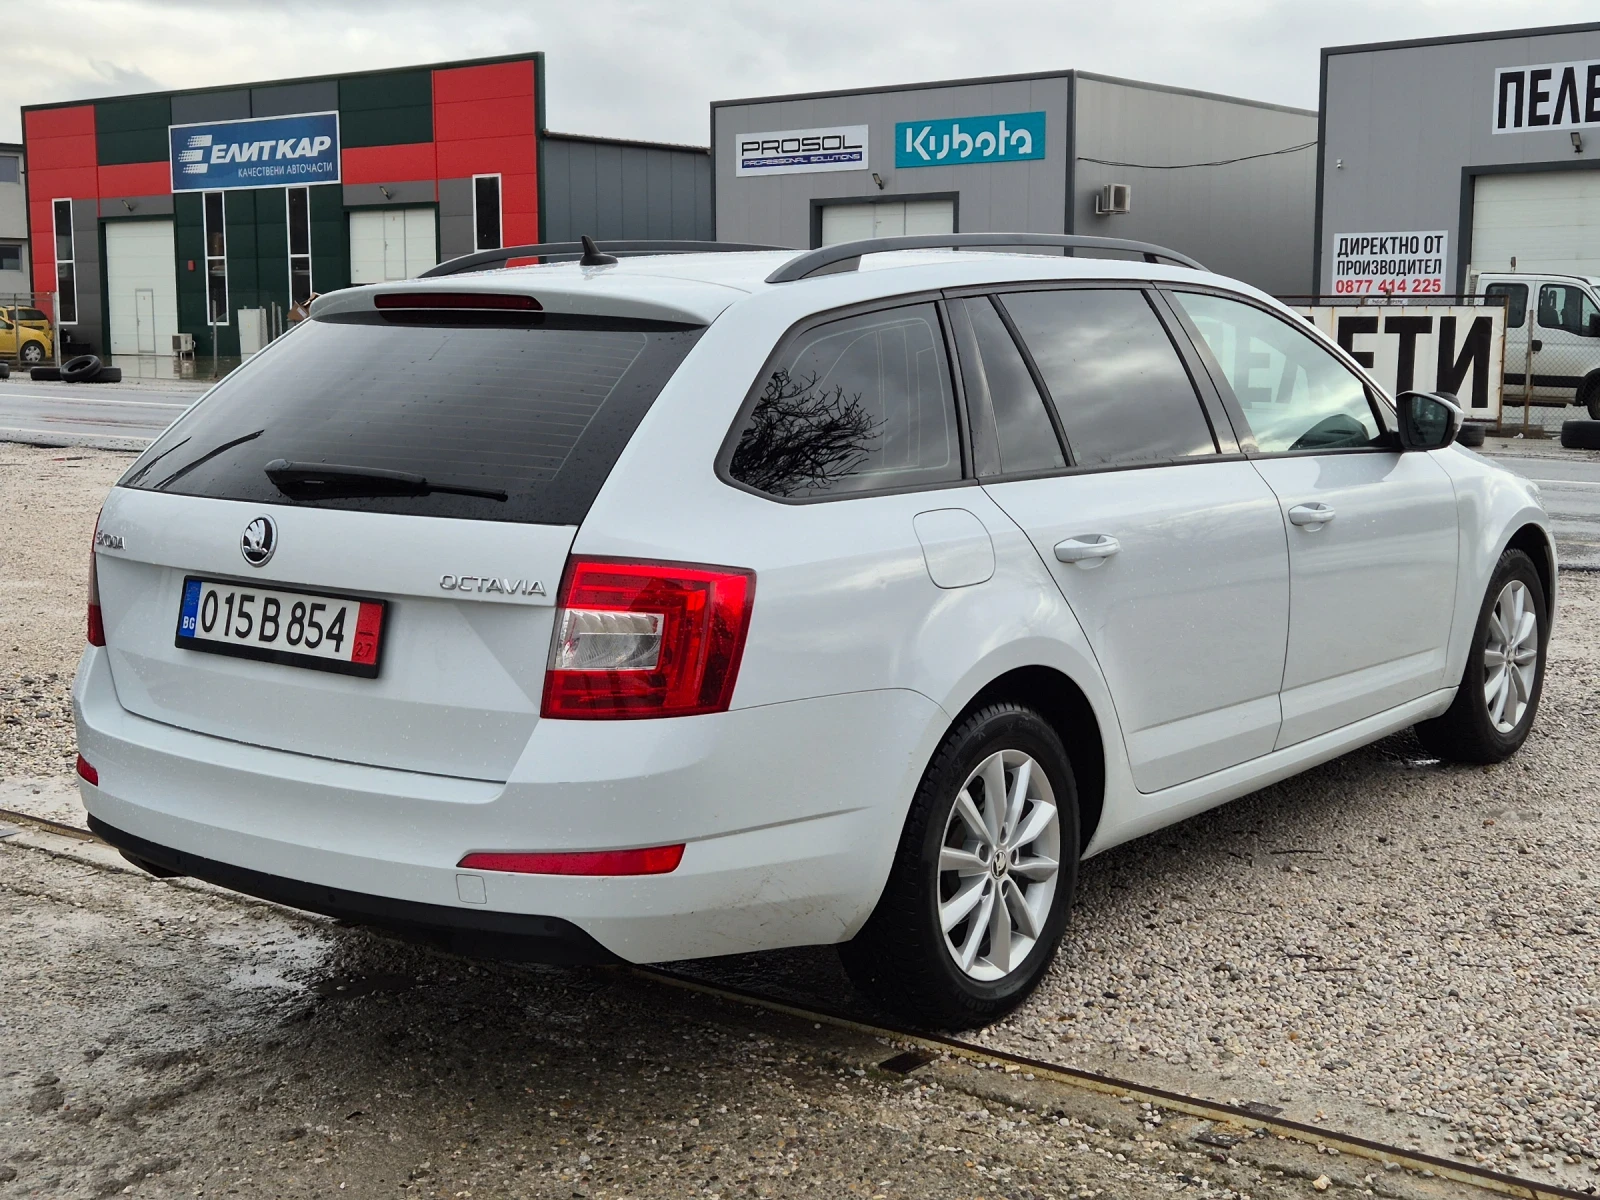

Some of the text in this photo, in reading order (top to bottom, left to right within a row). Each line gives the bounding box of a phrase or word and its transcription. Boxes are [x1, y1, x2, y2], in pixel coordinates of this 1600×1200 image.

[741, 135, 863, 156] PROSOL
[906, 120, 1033, 161] Kubota
[743, 153, 860, 167] PROFESSIONAL SOLUTIONS
[238, 162, 333, 178] КАЧЕСТВЕНИ АВТОЧАСТИ
[1337, 235, 1444, 258] ДИРЕКТНО ОТ
[1337, 258, 1442, 277] ПРОИЗВОДИТЕЛ
[1336, 278, 1442, 293] 0877 414 225
[440, 574, 547, 597] OCTAVIA
[182, 615, 196, 630] BG
[355, 641, 372, 658] 27
